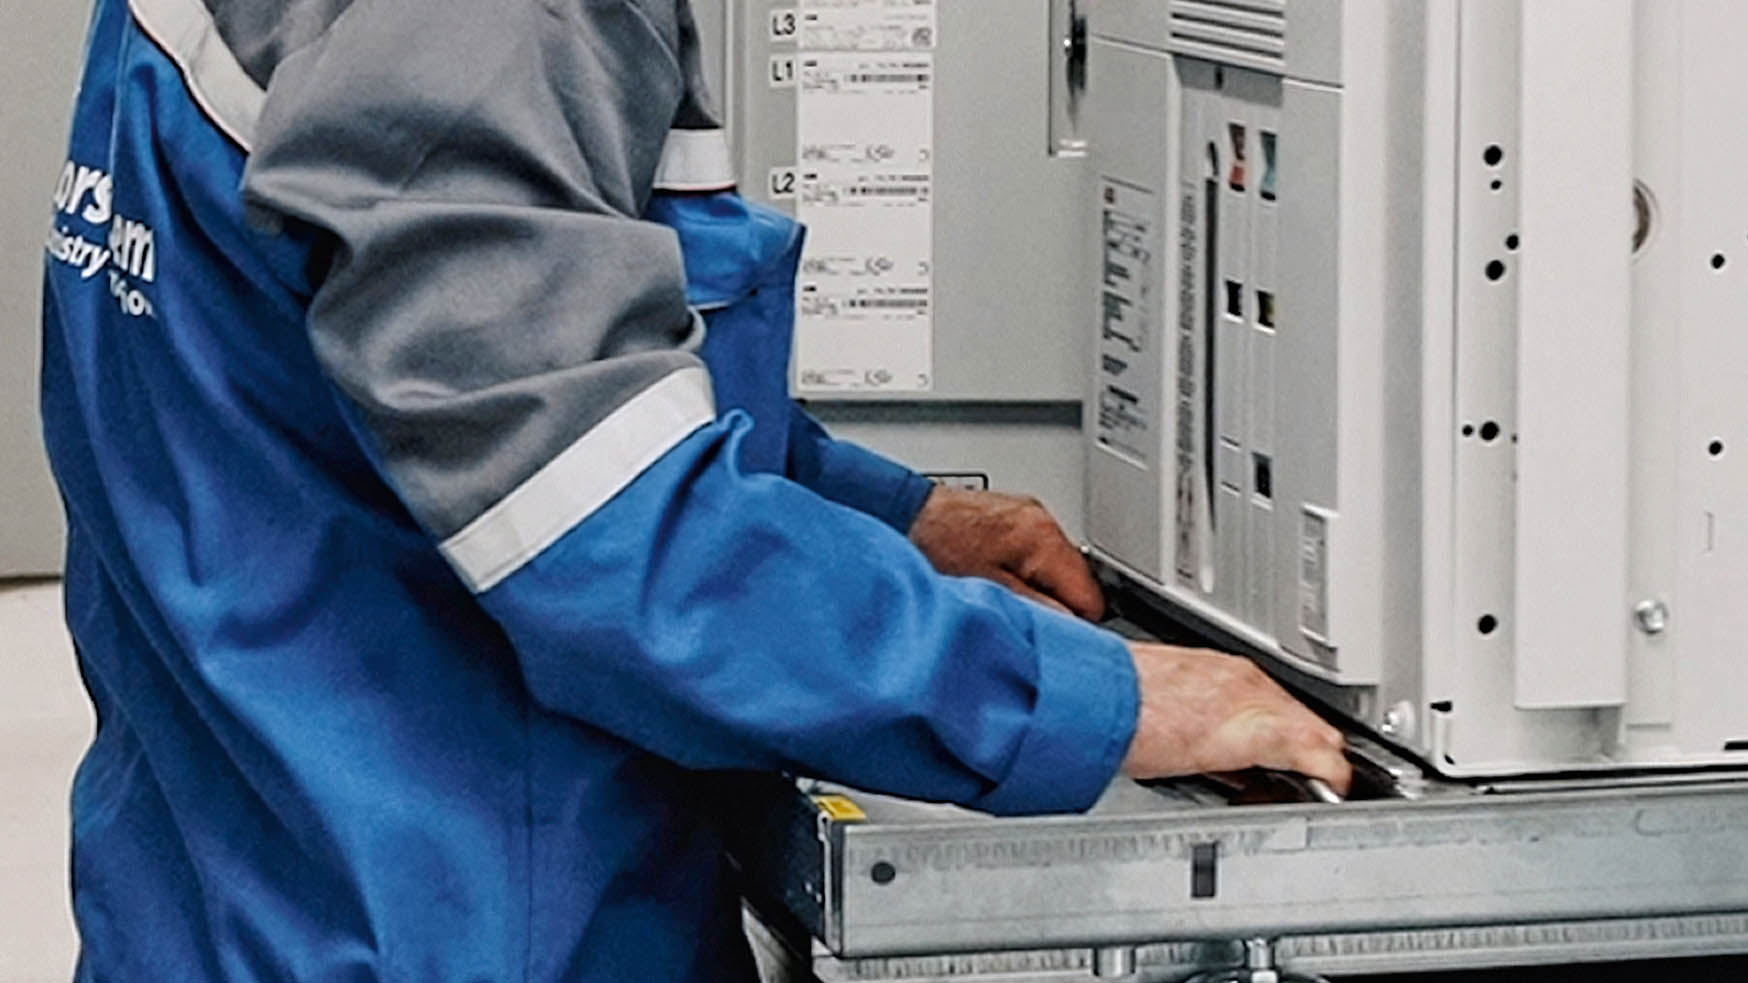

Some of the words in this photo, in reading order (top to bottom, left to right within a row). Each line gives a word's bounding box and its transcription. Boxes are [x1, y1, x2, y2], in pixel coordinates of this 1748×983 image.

[773, 13, 796, 35] L3
[772, 60, 793, 82] L1
[771, 171, 796, 194] L2
